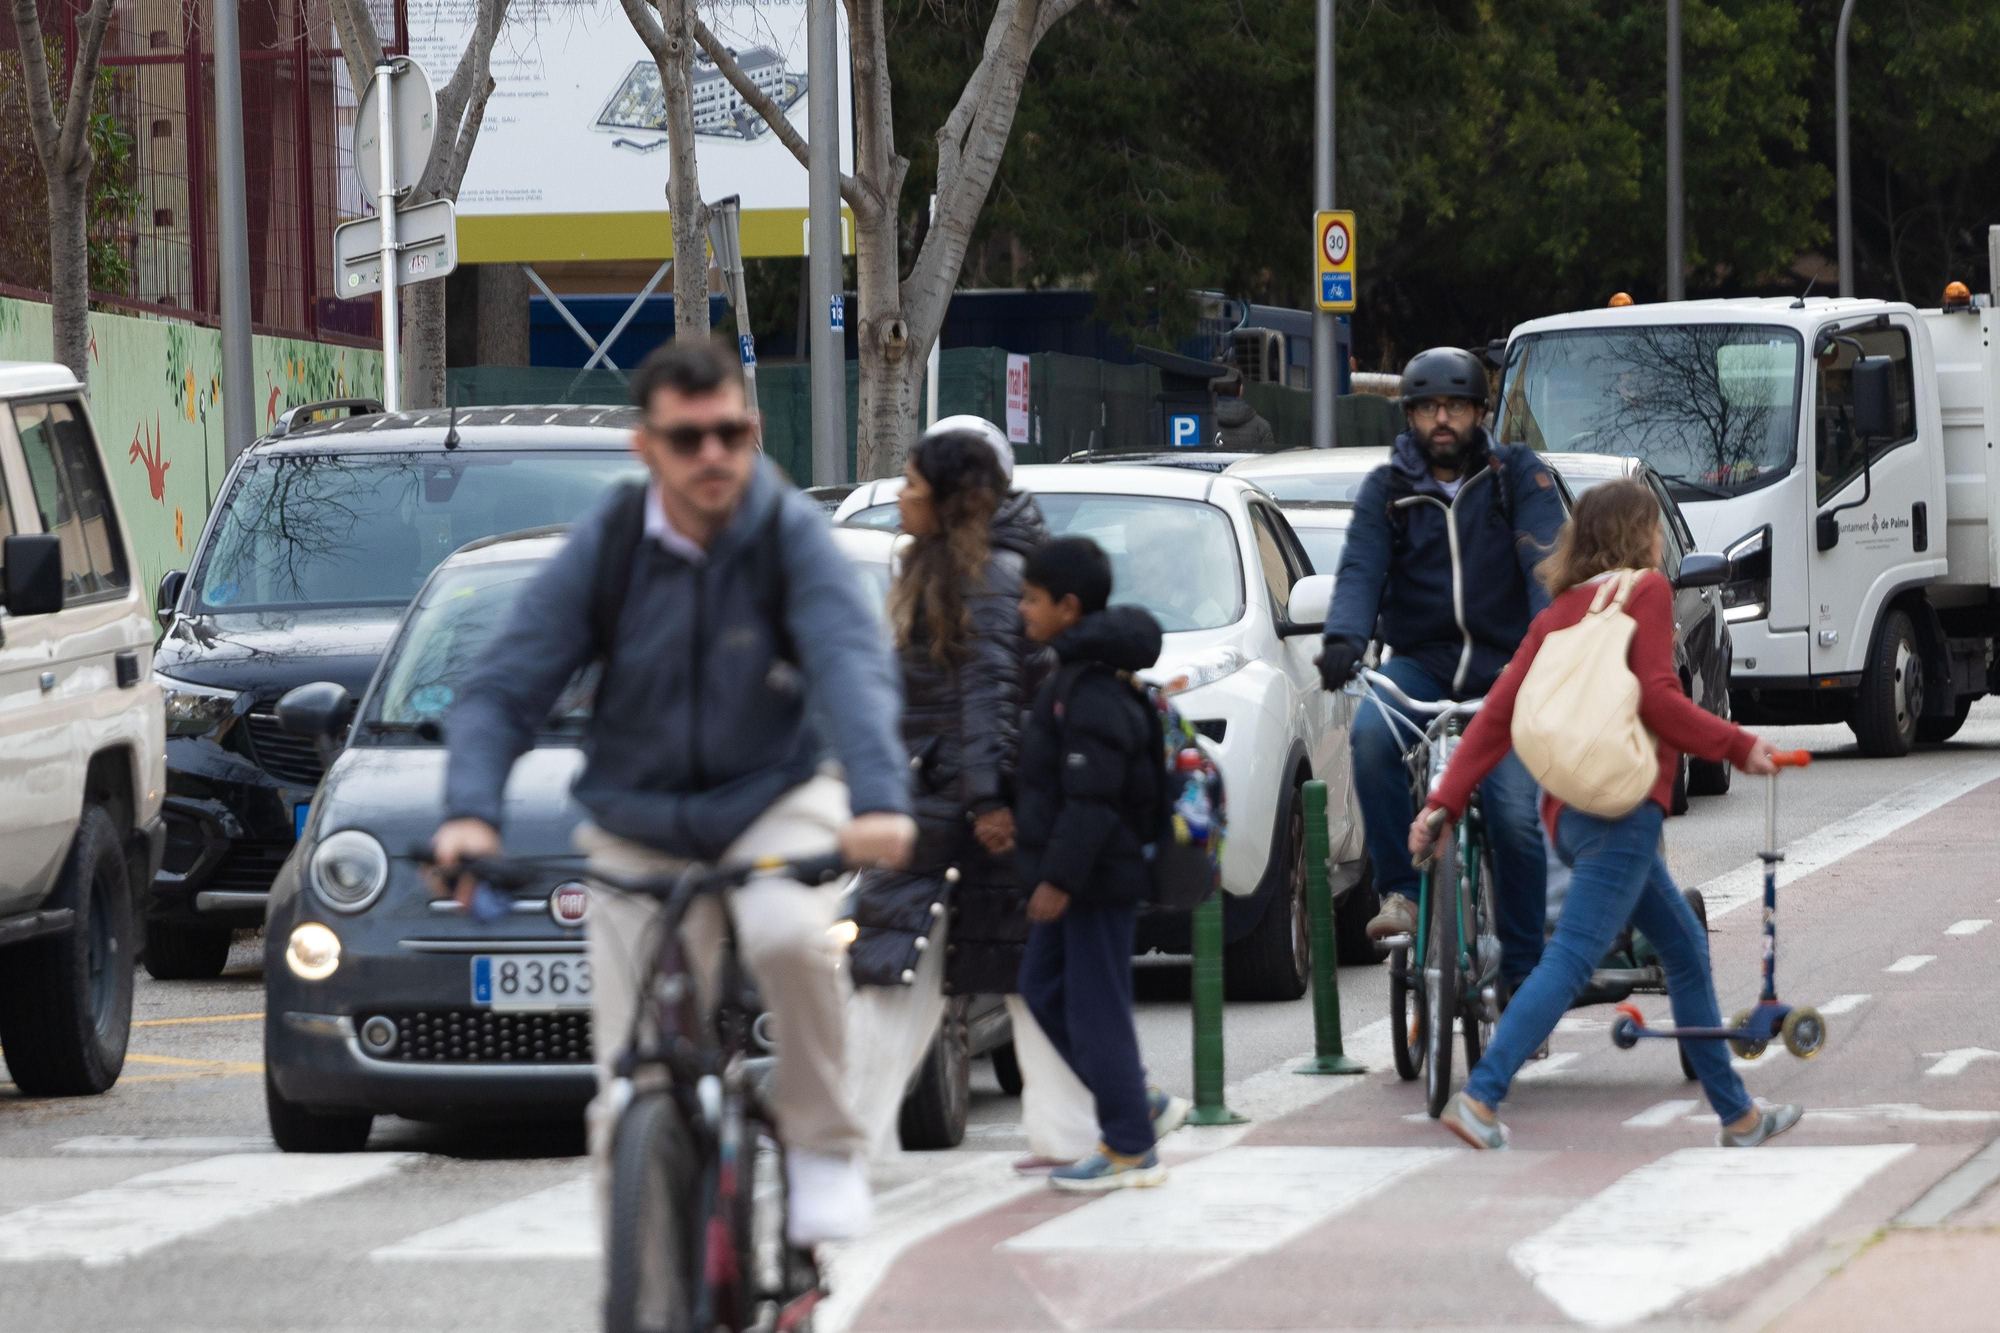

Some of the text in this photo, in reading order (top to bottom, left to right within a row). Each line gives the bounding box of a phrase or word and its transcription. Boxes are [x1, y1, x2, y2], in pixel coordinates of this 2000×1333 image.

[1329, 235, 1344, 250] 30
[1174, 417, 1196, 446] P
[1880, 518, 1889, 530] de
[1890, 516, 1909, 529] Palma
[500, 960, 593, 995] 8363
